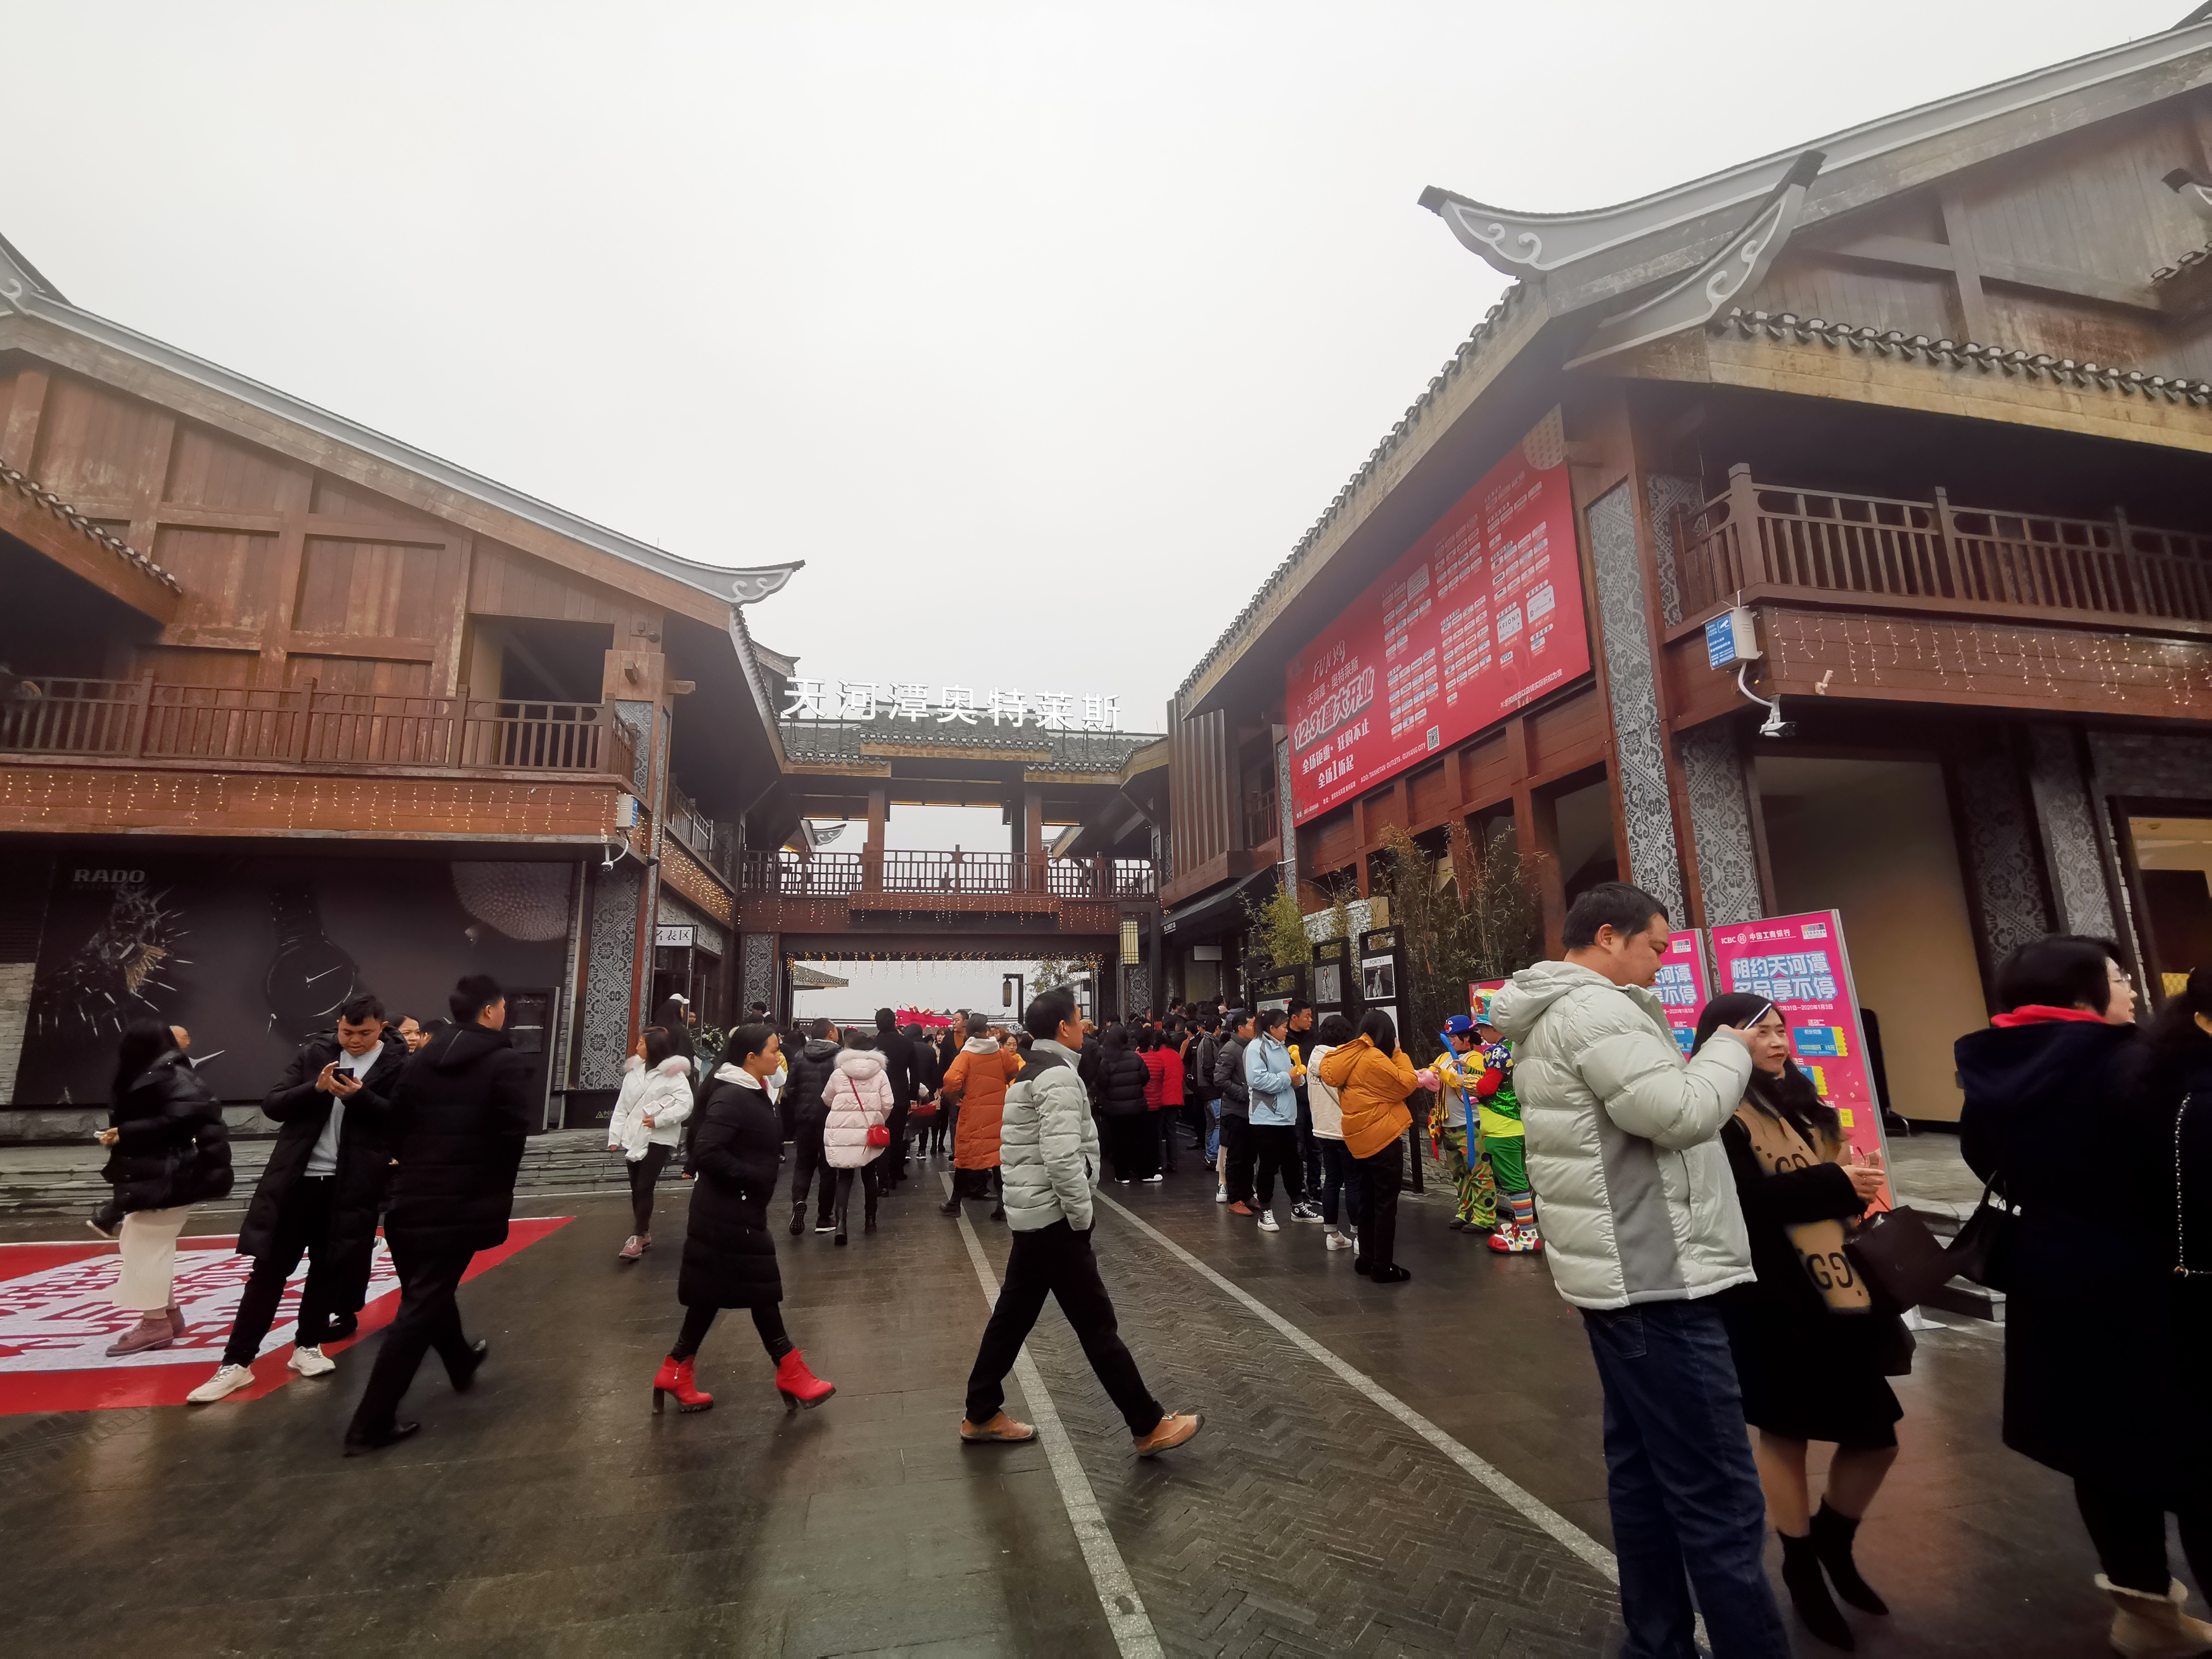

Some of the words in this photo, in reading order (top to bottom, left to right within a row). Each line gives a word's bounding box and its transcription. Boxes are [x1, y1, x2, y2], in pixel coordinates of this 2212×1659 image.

[781, 677, 1121, 732] 天河潭奥特莱斯
[1338, 718, 1370, 752] 狂购不止
[1319, 754, 1354, 789] 全场1折起
[73, 869, 146, 883] RADO
[1750, 929, 1790, 940] 中国工商银行
[1731, 951, 1831, 979] 相约天河潭
